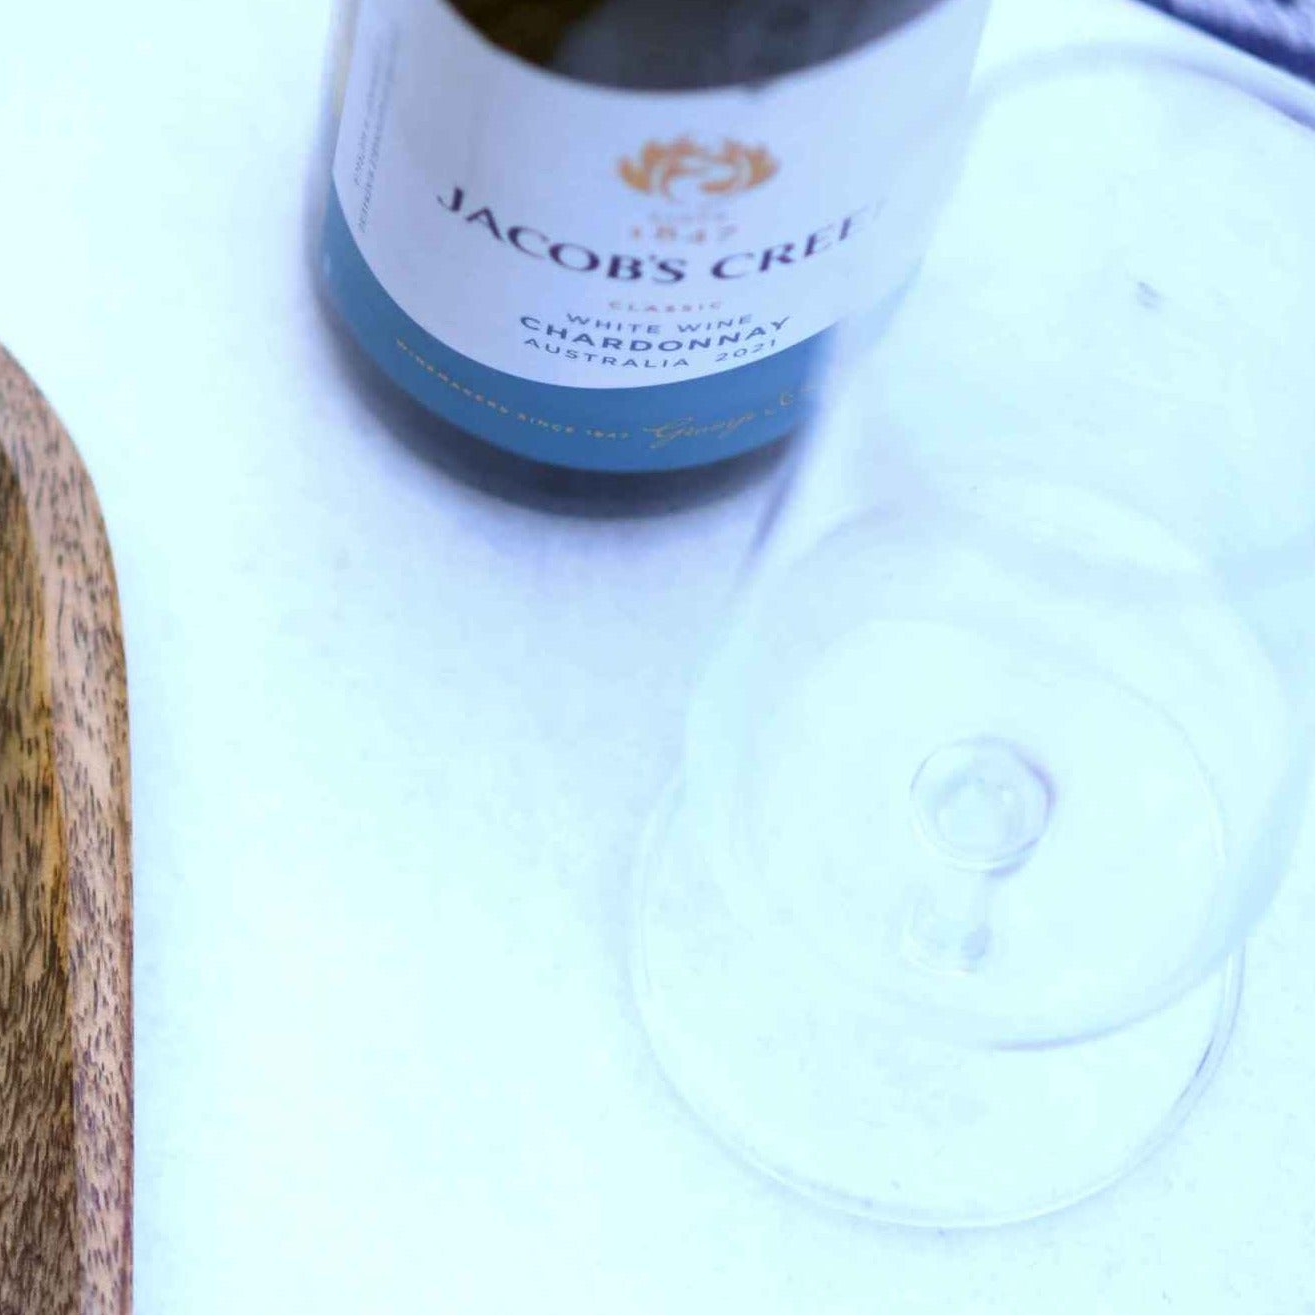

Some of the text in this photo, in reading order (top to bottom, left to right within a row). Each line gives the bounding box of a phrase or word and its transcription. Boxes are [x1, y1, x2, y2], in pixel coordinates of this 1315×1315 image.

[437, 187, 888, 284] JACOB'S CREE
[520, 315, 791, 352] CHARDONNAY
[566, 313, 753, 335] WHITE WINE
[524, 337, 689, 368] AUSTRALIA
